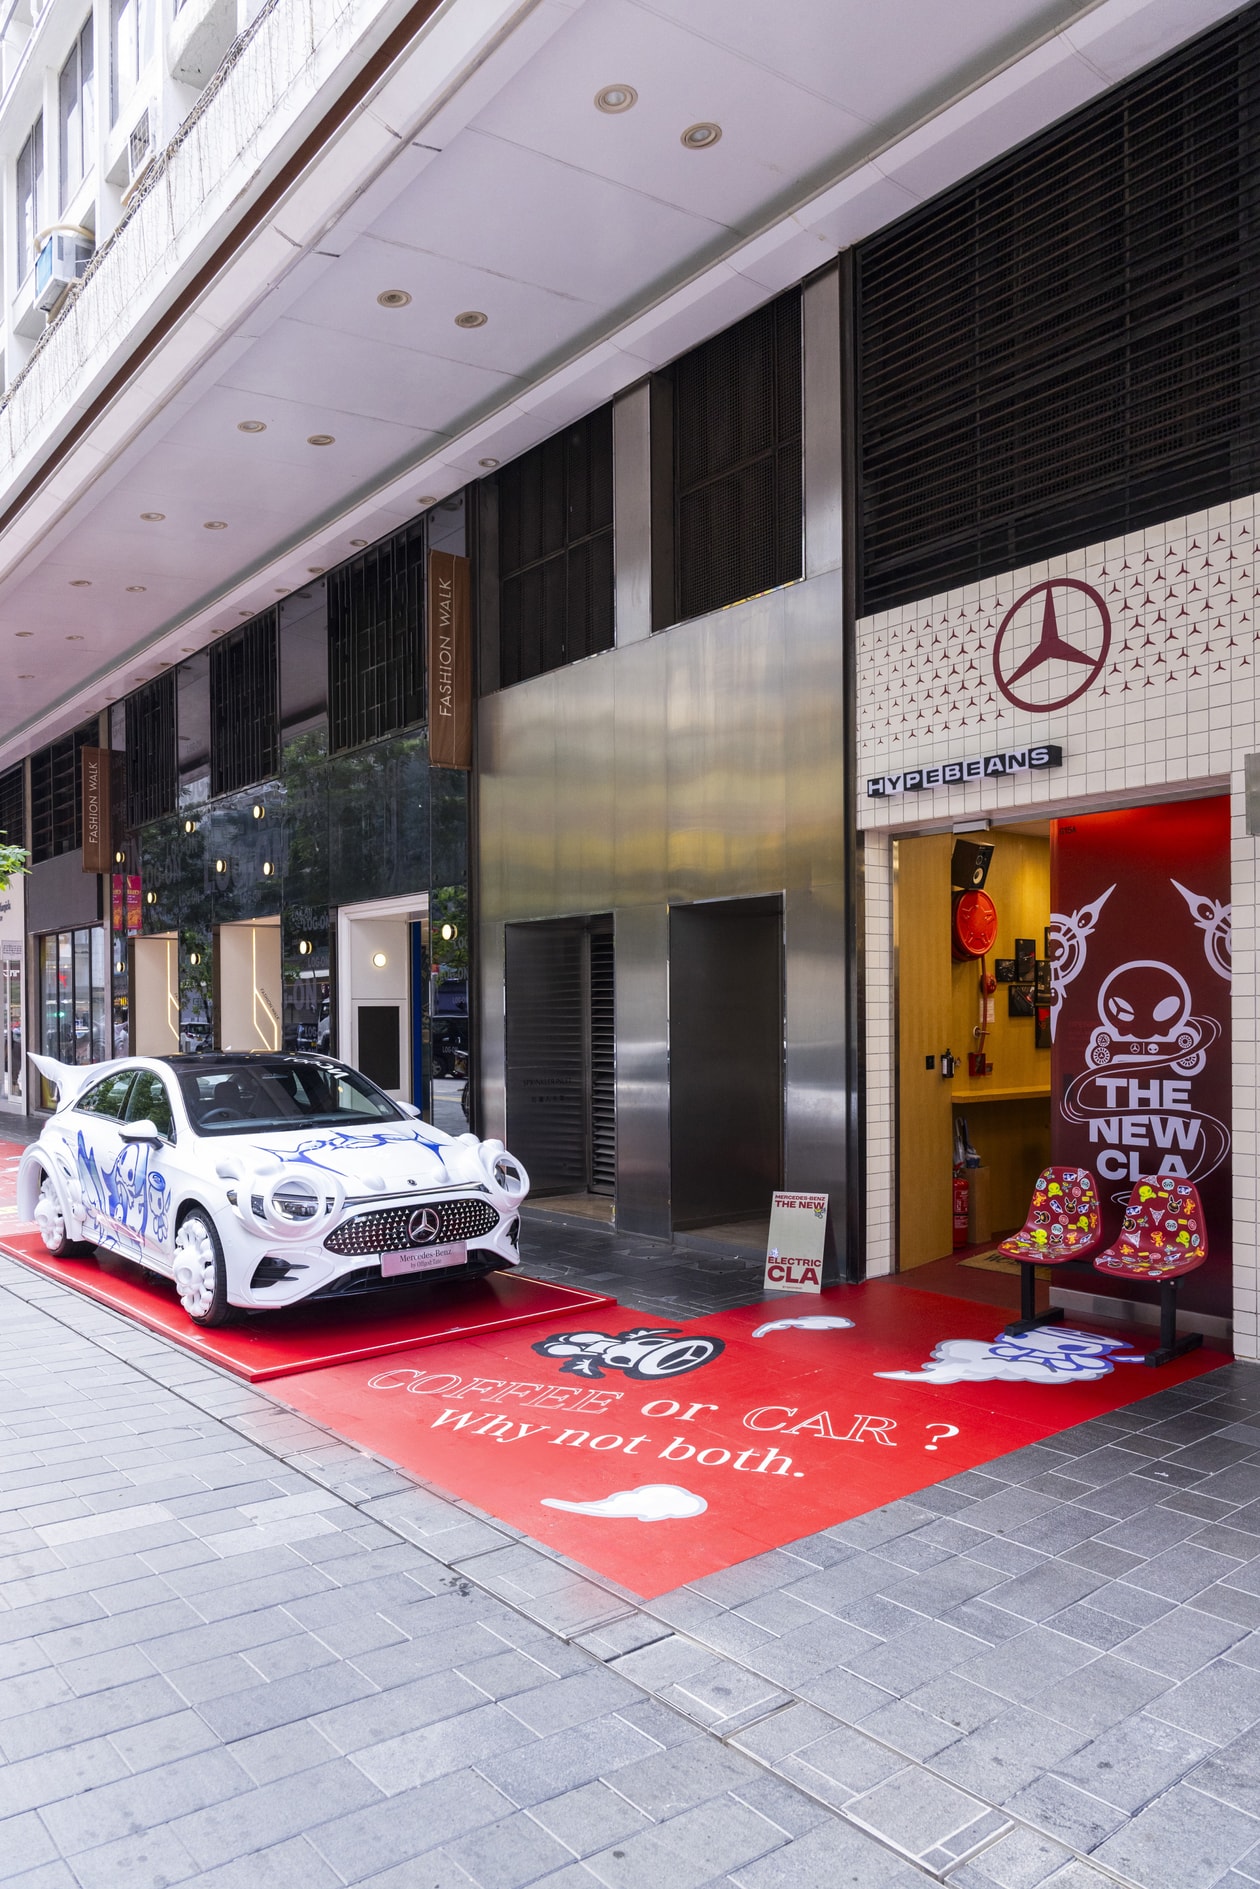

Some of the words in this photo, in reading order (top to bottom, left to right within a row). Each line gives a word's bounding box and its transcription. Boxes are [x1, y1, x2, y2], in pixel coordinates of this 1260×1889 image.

[438, 577, 452, 627] WALK
[438, 636, 452, 717] FASHION
[88, 762, 98, 791] WALK
[867, 748, 1050, 796] HYPEBEANS
[88, 796, 98, 844] FASHION
[1095, 1077, 1192, 1110] THE
[1089, 1115, 1202, 1150] NEW
[1096, 1149, 1189, 1181] CLA
[774, 1194, 826, 1202] MERCEDES-BENZ
[774, 1200, 797, 1209] THE
[798, 1201, 825, 1210] NEW
[399, 1249, 452, 1262] Mercedes-Benz
[767, 1256, 822, 1267] ELECTRIC
[767, 1265, 820, 1285] CLA
[366, 1368, 624, 1415] COFFEE
[640, 1398, 719, 1423] or
[742, 1405, 899, 1447] CAR
[923, 1423, 960, 1451] ?
[430, 1407, 551, 1443] Why
[548, 1426, 653, 1456] not
[657, 1436, 806, 1478] both.
